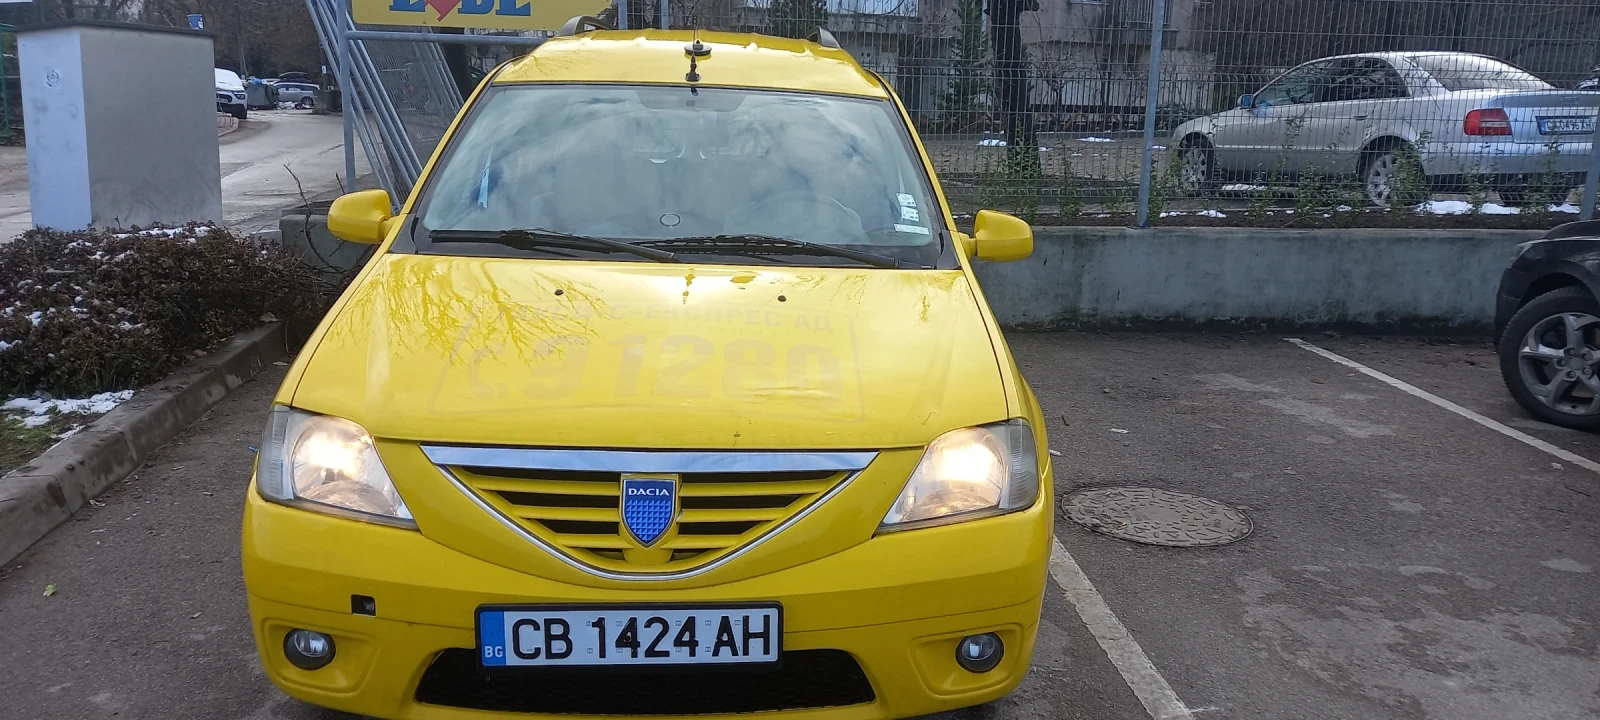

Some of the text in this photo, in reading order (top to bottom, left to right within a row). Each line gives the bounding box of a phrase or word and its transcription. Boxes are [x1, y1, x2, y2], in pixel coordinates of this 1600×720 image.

[523, 334, 843, 410] 91280
[628, 487, 670, 496] DACIA
[484, 645, 504, 658] BG
[512, 614, 771, 660] CB 1424 AH
